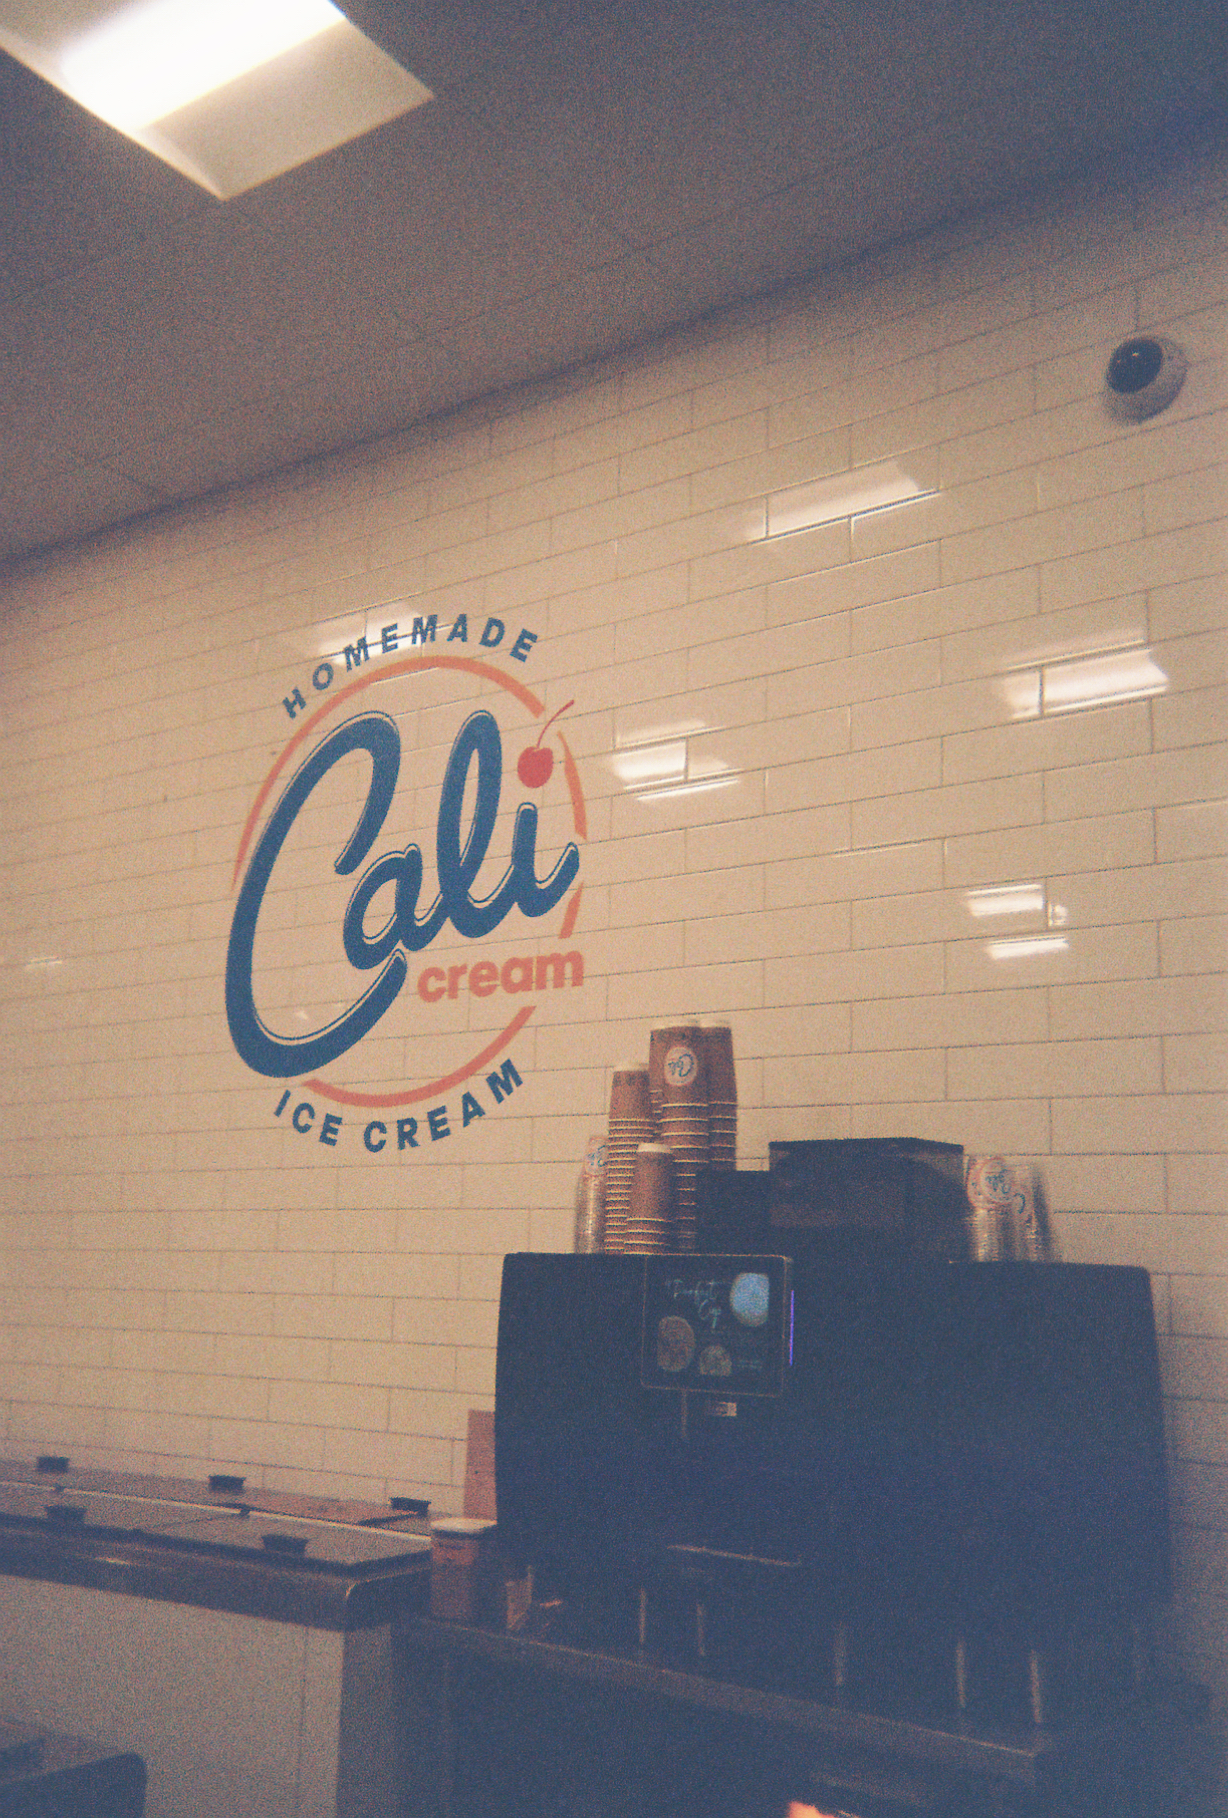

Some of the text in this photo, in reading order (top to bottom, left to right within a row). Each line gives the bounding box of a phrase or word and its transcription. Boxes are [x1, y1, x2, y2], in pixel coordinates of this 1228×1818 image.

[282, 613, 538, 719] HOMEMADE
[225, 710, 580, 1078] Cali
[417, 949, 584, 1003] cream
[274, 1058, 524, 1153] ICE CREAM
